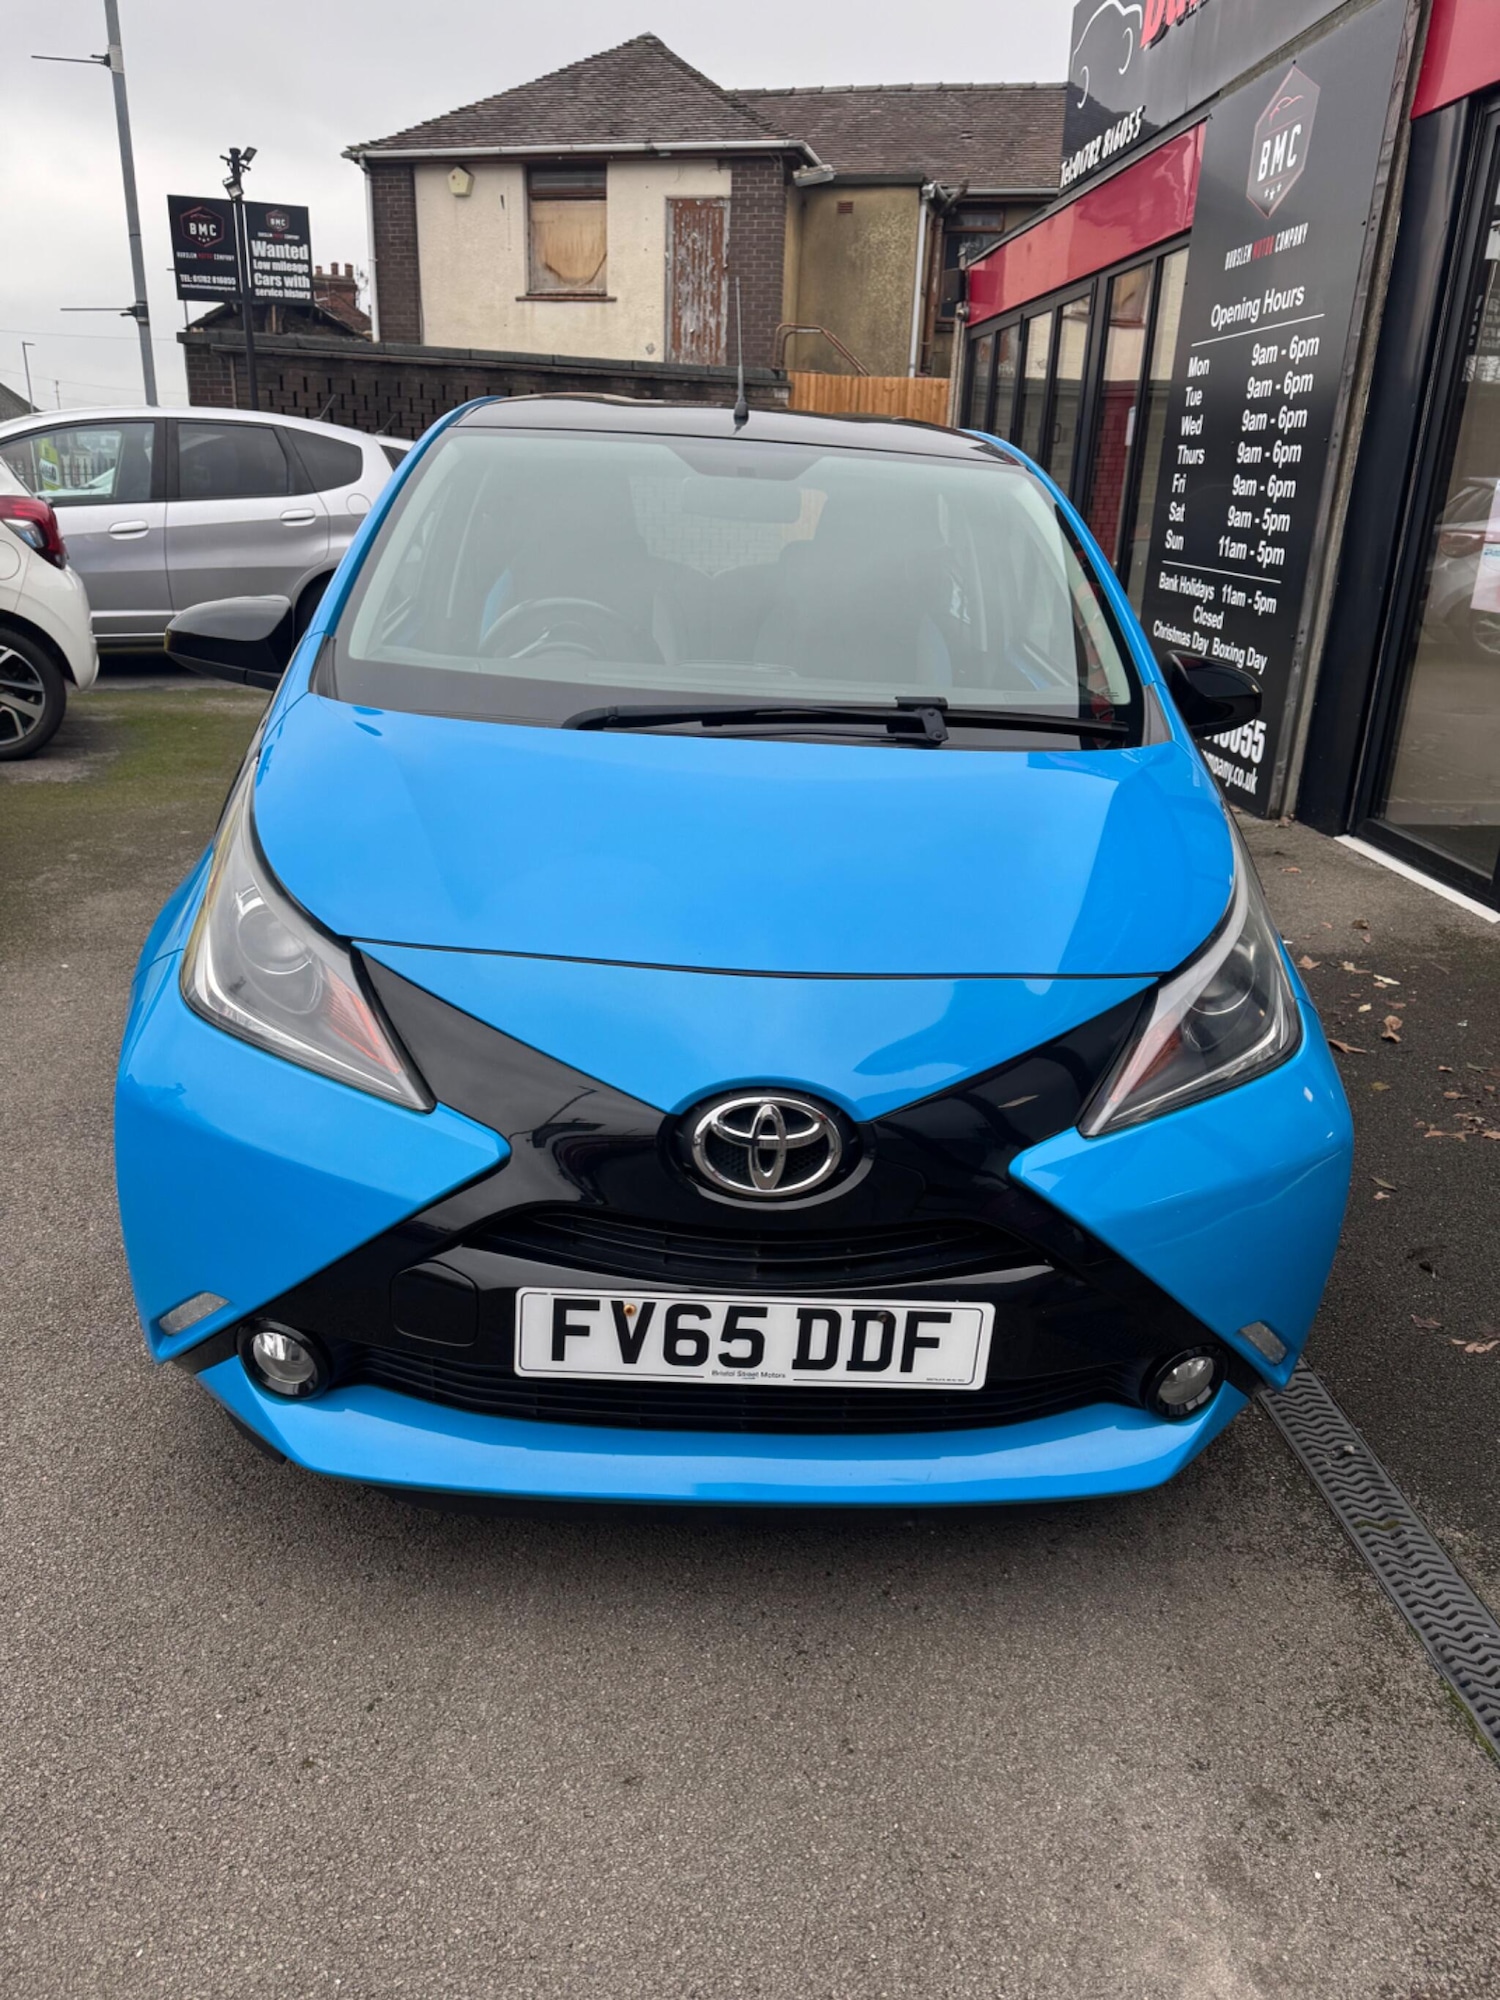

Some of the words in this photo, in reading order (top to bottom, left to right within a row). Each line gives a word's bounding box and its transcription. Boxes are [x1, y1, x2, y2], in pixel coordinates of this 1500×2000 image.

[1102, 105, 1144, 158] 816055
[1257, 124, 1302, 182] BMC
[189, 222, 217, 236] BMC
[1274, 222, 1308, 253] COMPANY
[251, 240, 309, 260] Wanted
[252, 259, 271, 270] Low
[272, 260, 309, 274] mileage
[254, 272, 282, 287] Cars
[283, 274, 310, 288] with
[254, 288, 284, 298] service
[284, 288, 312, 300] history
[1210, 297, 1261, 331] Opening
[1263, 286, 1305, 314] Hours
[1188, 356, 1210, 378] Mon
[1251, 343, 1278, 366] 9am
[1288, 335, 1320, 364] 6pm
[1185, 386, 1202, 407] Tue
[1246, 376, 1272, 400] 9am
[1284, 371, 1314, 400] 6pm
[1180, 414, 1204, 436] Wed
[1241, 410, 1267, 432] 9am
[1278, 406, 1308, 434] 6pm
[1177, 444, 1205, 465] Thurs
[1236, 442, 1262, 464] 9am
[1272, 440, 1302, 468] 6pm
[1172, 473, 1187, 494] Fri
[1232, 474, 1258, 496] 9am
[1266, 474, 1296, 503] 6pm
[1168, 501, 1186, 522] Sat
[1226, 505, 1252, 528] 9am
[1262, 507, 1291, 536] 5pm
[1165, 529, 1184, 550] Sun
[1218, 535, 1248, 560] 11am
[1256, 540, 1286, 568] 5pm
[1158, 572, 1180, 591] Bank
[1180, 575, 1215, 603] Holidays
[1222, 584, 1246, 608] 11am
[1253, 590, 1277, 616] 5pm
[1193, 604, 1225, 630] Closed
[1153, 619, 1191, 648] Christmas
[1192, 632, 1210, 656] Day
[1212, 636, 1246, 669] Boxing
[1246, 646, 1268, 676] Day
[551, 1297, 768, 1370] FV65
[791, 1307, 953, 1374] DDF
